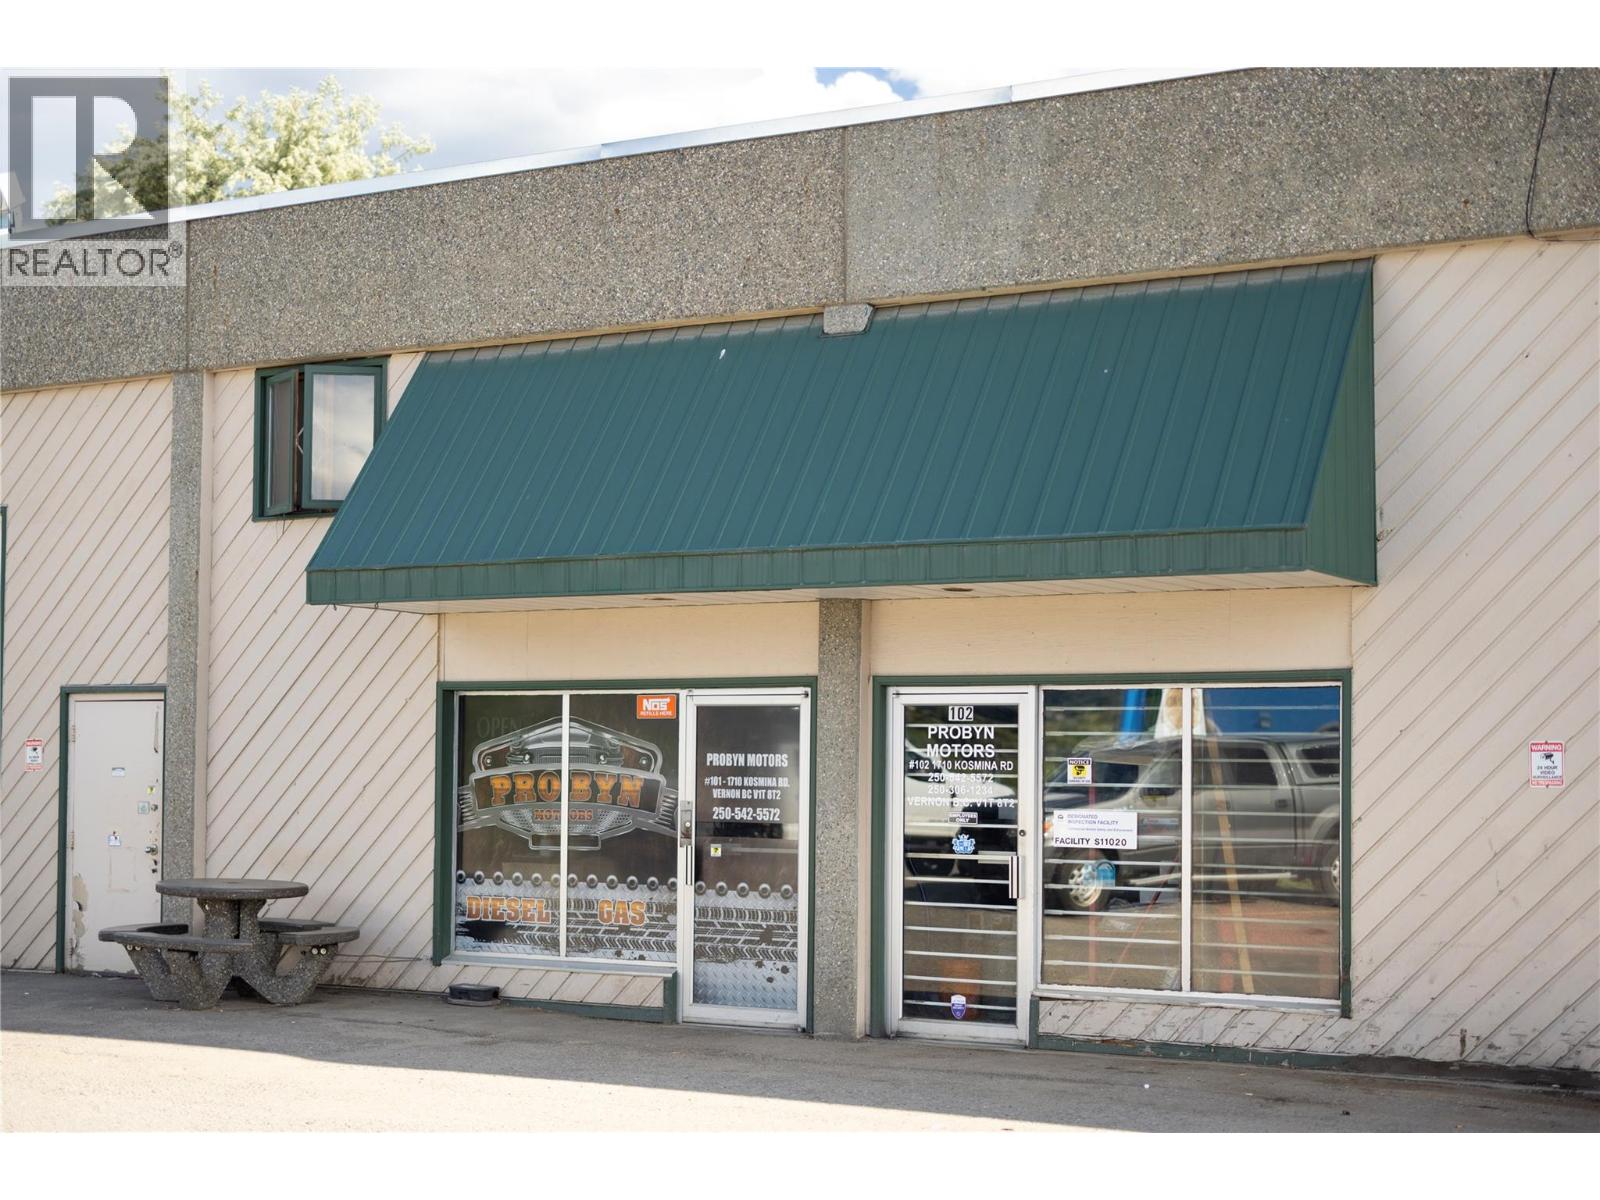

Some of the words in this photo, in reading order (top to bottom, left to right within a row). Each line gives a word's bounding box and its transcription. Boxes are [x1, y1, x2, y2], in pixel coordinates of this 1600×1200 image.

[642, 697, 671, 711] NOS
[950, 706, 973, 720] 102
[927, 725, 995, 739] PROBYN
[926, 743, 995, 758] MOTORS
[706, 752, 745, 767] PROBYN
[746, 753, 789, 767] MOTORS
[909, 760, 930, 770] #102
[932, 760, 952, 770] 1710
[954, 760, 997, 771] KOSMINA
[1000, 760, 1014, 771] RD
[704, 776, 722, 786] #101
[727, 776, 742, 787] 1710
[743, 776, 777, 787] KOSMINA
[489, 770, 645, 808] PROBYN
[712, 788, 741, 799] VERNON
[741, 789, 752, 799] BC
[753, 789, 766, 800] V1T
[767, 789, 781, 800] 8T2
[927, 784, 994, 795] 250-306-1234
[907, 796, 950, 807] VERNON
[976, 798, 994, 808] V1T
[997, 798, 1015, 808] 8T2
[532, 809, 594, 822] MOTORS
[712, 806, 781, 821] 250-542-5572
[1055, 837, 1091, 845] FACILITY
[1094, 838, 1127, 847] S11020
[466, 895, 551, 924] DIESEL
[598, 898, 647, 926] GAS
